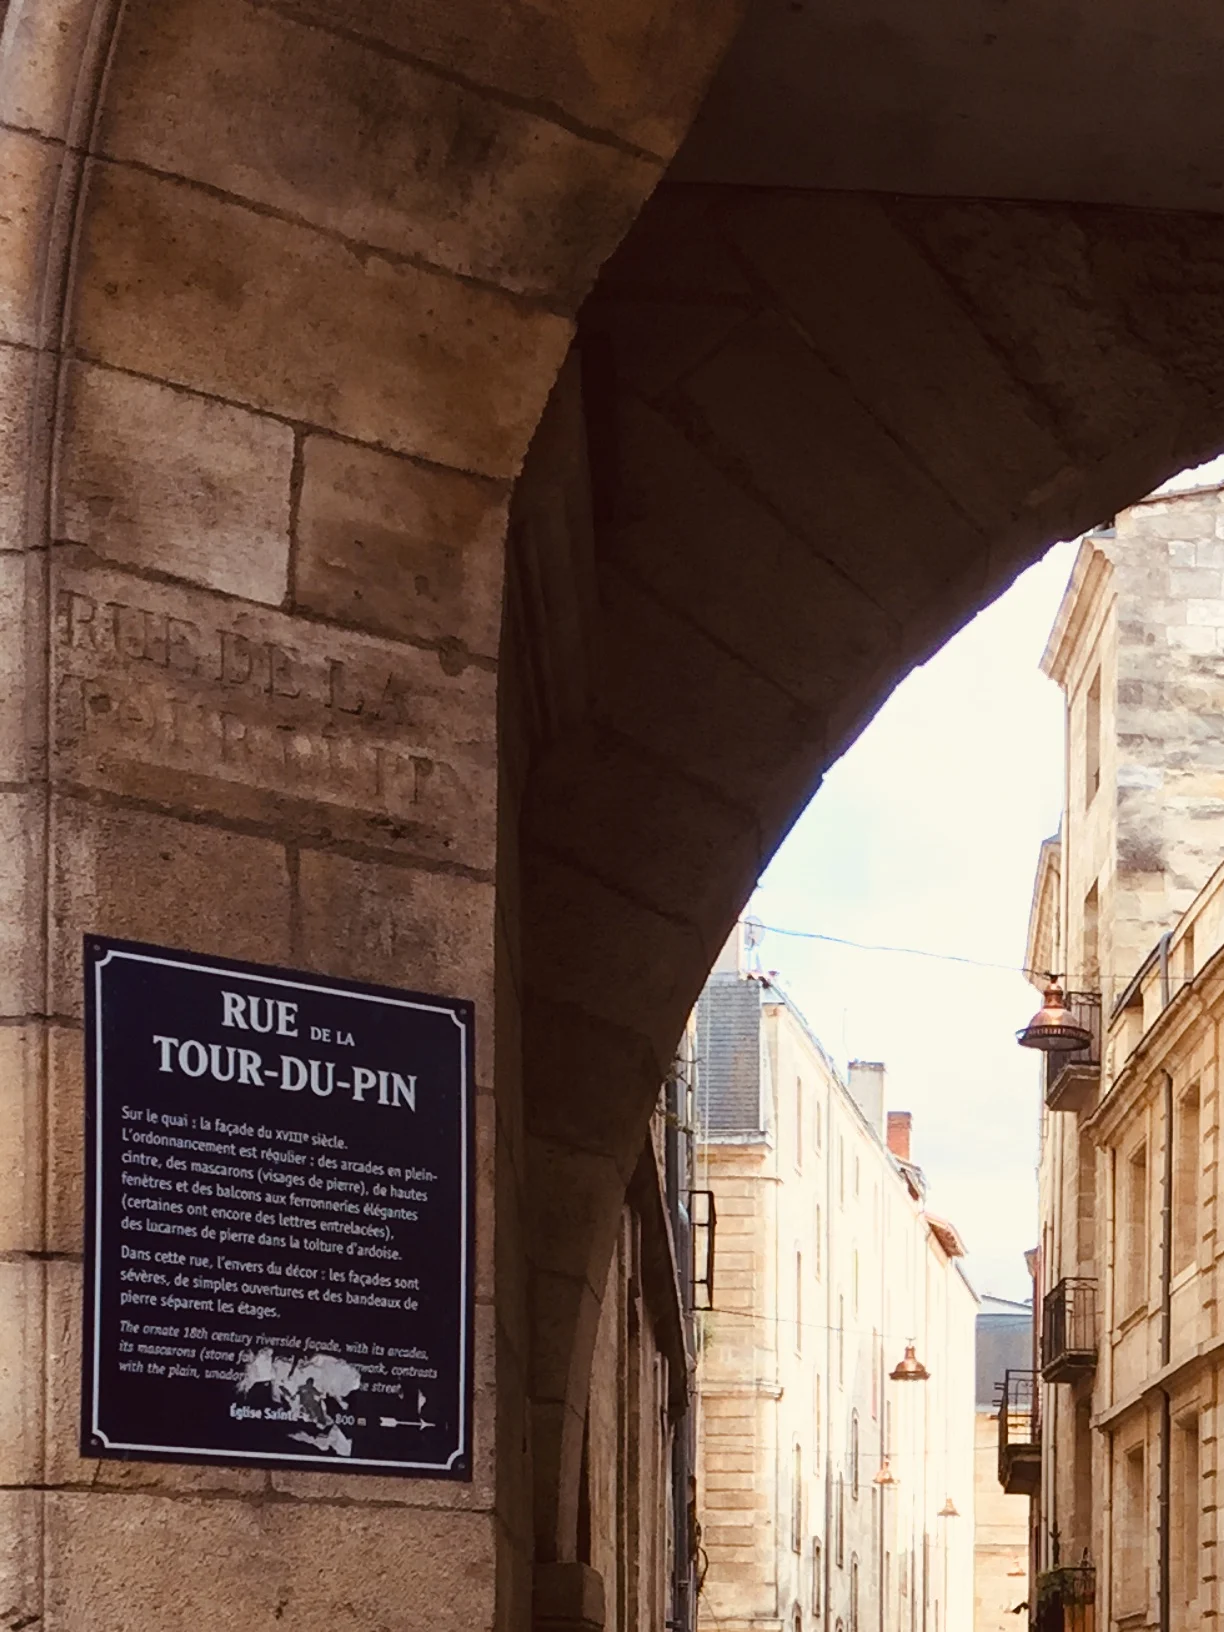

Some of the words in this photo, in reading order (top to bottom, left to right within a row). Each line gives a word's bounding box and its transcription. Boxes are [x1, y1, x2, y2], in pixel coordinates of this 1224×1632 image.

[221, 991, 298, 1037] RUE
[310, 1026, 331, 1042] DE
[337, 1031, 355, 1047] LA
[153, 1035, 417, 1112] TOUR-DU-PIN
[122, 1105, 143, 1120] Sur
[147, 1109, 158, 1124] le
[161, 1114, 188, 1127] quai
[200, 1117, 211, 1130] la
[215, 1118, 254, 1137] façade
[257, 1125, 272, 1139] du
[311, 1133, 348, 1149] siècle.
[121, 1150, 162, 1169] cintre,
[166, 1156, 187, 1171] des
[191, 1162, 254, 1179] mascarons
[257, 1168, 305, 1187] (visages
[308, 1175, 323, 1188] de
[327, 1177, 369, 1196] pierre),
[373, 1183, 387, 1196] de
[390, 1185, 428, 1202] hautes
[239, 1147, 257, 1159] est
[261, 1148, 306, 1164] régulier
[318, 1155, 338, 1169] des
[341, 1161, 385, 1175] arcades
[388, 1167, 401, 1177] en
[405, 1167, 437, 1181] plein-
[121, 1171, 172, 1190] fenêtres
[176, 1180, 189, 1193] et
[191, 1181, 213, 1196] des
[216, 1183, 262, 1202] balcons
[265, 1193, 286, 1205] aux
[289, 1192, 360, 1214] ferronneries
[363, 1203, 418, 1221] élégantes
[122, 1193, 183, 1214] (certaines
[187, 1205, 208, 1216] ont
[211, 1208, 252, 1222] encore
[255, 1210, 275, 1225] des
[279, 1213, 317, 1230] lettres
[320, 1221, 394, 1241] entrelacées),
[121, 1216, 143, 1231] des
[146, 1218, 197, 1237] lucarnes
[201, 1225, 216, 1239] de
[220, 1228, 255, 1244] pierre
[258, 1233, 286, 1247] dans
[290, 1235, 300, 1249] la
[304, 1238, 344, 1254] toiture
[120, 1268, 170, 1286] sévères,
[174, 1273, 189, 1287] de
[193, 1276, 238, 1293] simples
[241, 1283, 304, 1299] ouvertures
[307, 1289, 320, 1301] et
[323, 1289, 343, 1303] des
[346, 1291, 401, 1308] bandeaux
[404, 1297, 418, 1310] de
[121, 1245, 151, 1261] Dans
[154, 1251, 186, 1265] cette
[190, 1256, 213, 1269] rue,
[266, 1262, 282, 1275] du
[285, 1264, 318, 1279] décor
[329, 1268, 345, 1282] les
[348, 1270, 391, 1287] façades
[394, 1278, 419, 1290] sont
[121, 1290, 157, 1306] pierre
[161, 1295, 214, 1311] séparent
[218, 1299, 234, 1313] les
[238, 1301, 280, 1319] étages.
[119, 1339, 134, 1353] its
[137, 1343, 196, 1359] mascarons
[199, 1347, 235, 1364] (stone
[391, 1365, 438, 1379] contrasts
[120, 1320, 140, 1333] The
[143, 1325, 180, 1337] ornate
[184, 1327, 208, 1339] 18th
[211, 1332, 253, 1346] century
[256, 1336, 301, 1348] riverside
[303, 1337, 341, 1353] façade,
[346, 1343, 368, 1354] with
[372, 1343, 384, 1355] its
[388, 1347, 428, 1360] arcades,
[118, 1361, 144, 1373] with
[146, 1363, 166, 1375] the
[167, 1364, 200, 1381] plain,
